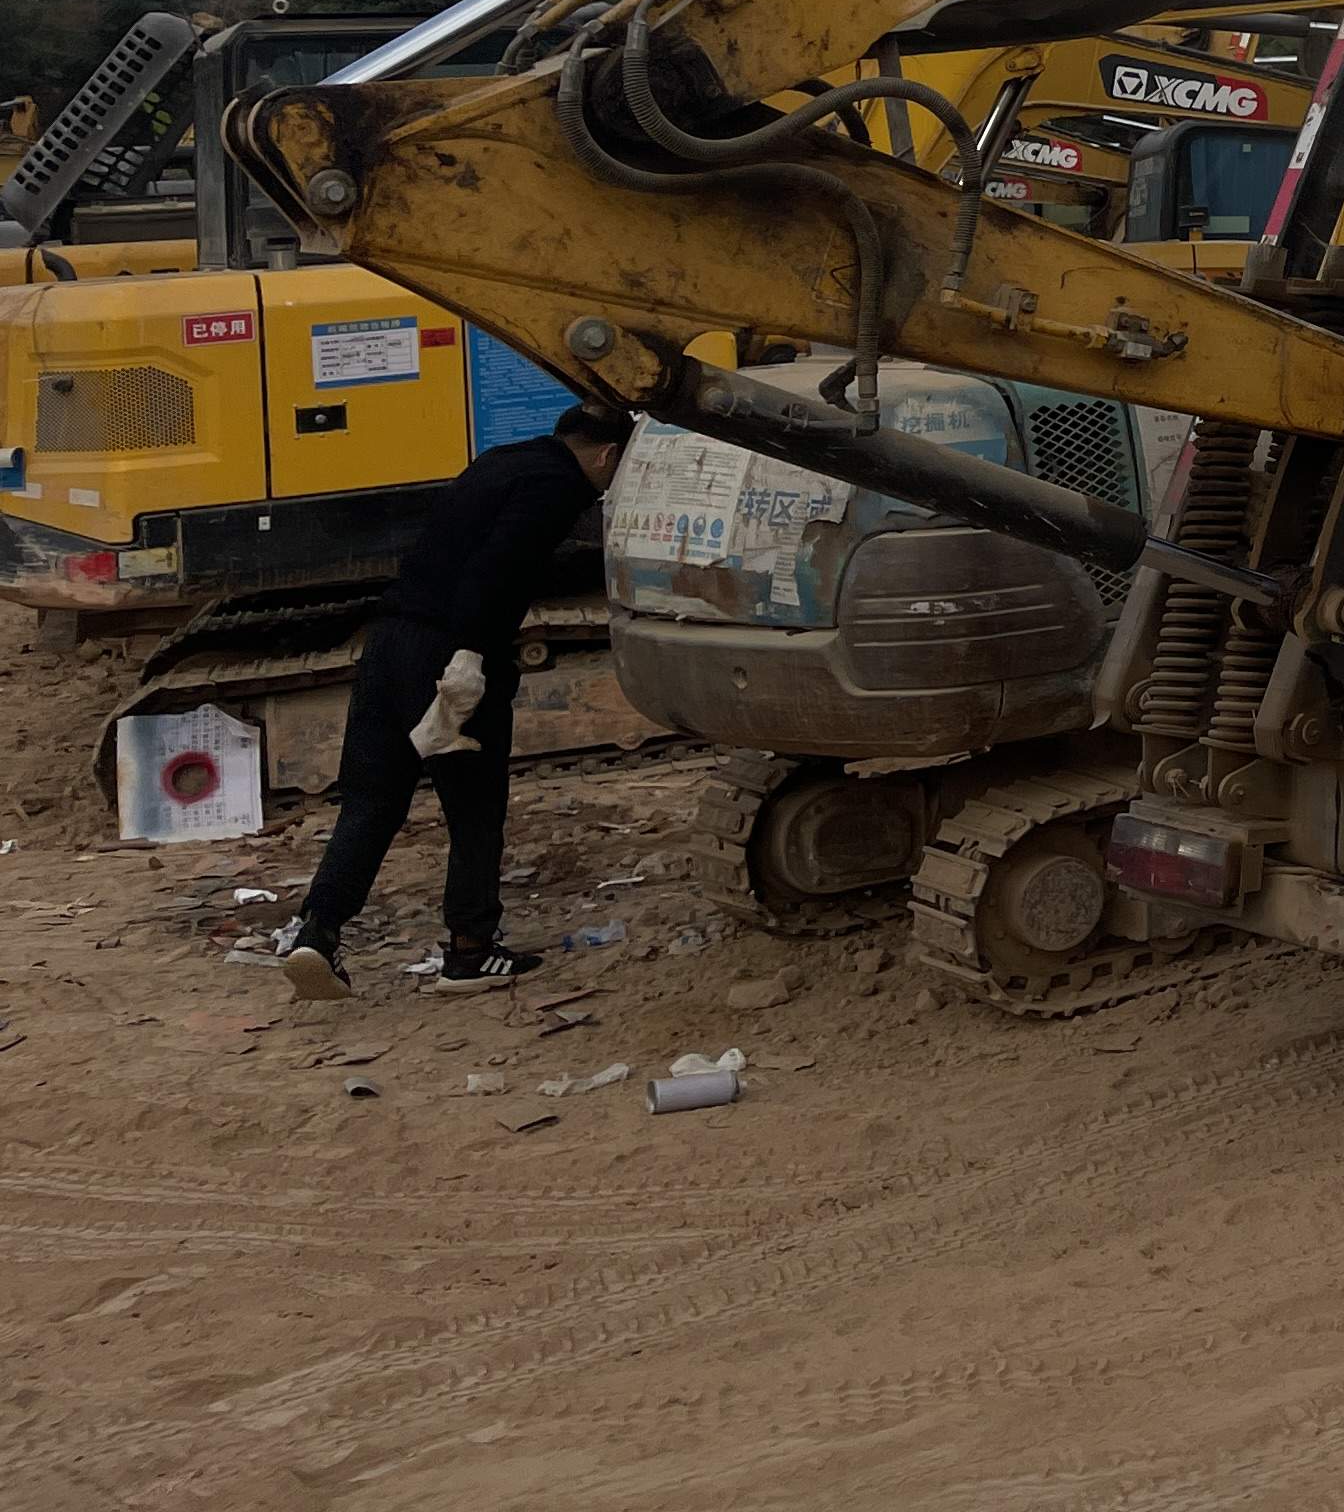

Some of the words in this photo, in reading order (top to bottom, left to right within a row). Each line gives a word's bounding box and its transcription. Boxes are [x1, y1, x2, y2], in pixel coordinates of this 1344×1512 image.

[1144, 74, 1259, 118] XCMG
[1001, 138, 1079, 170] XCMG
[984, 180, 1027, 201] CMG
[192, 319, 246, 339] 已停用
